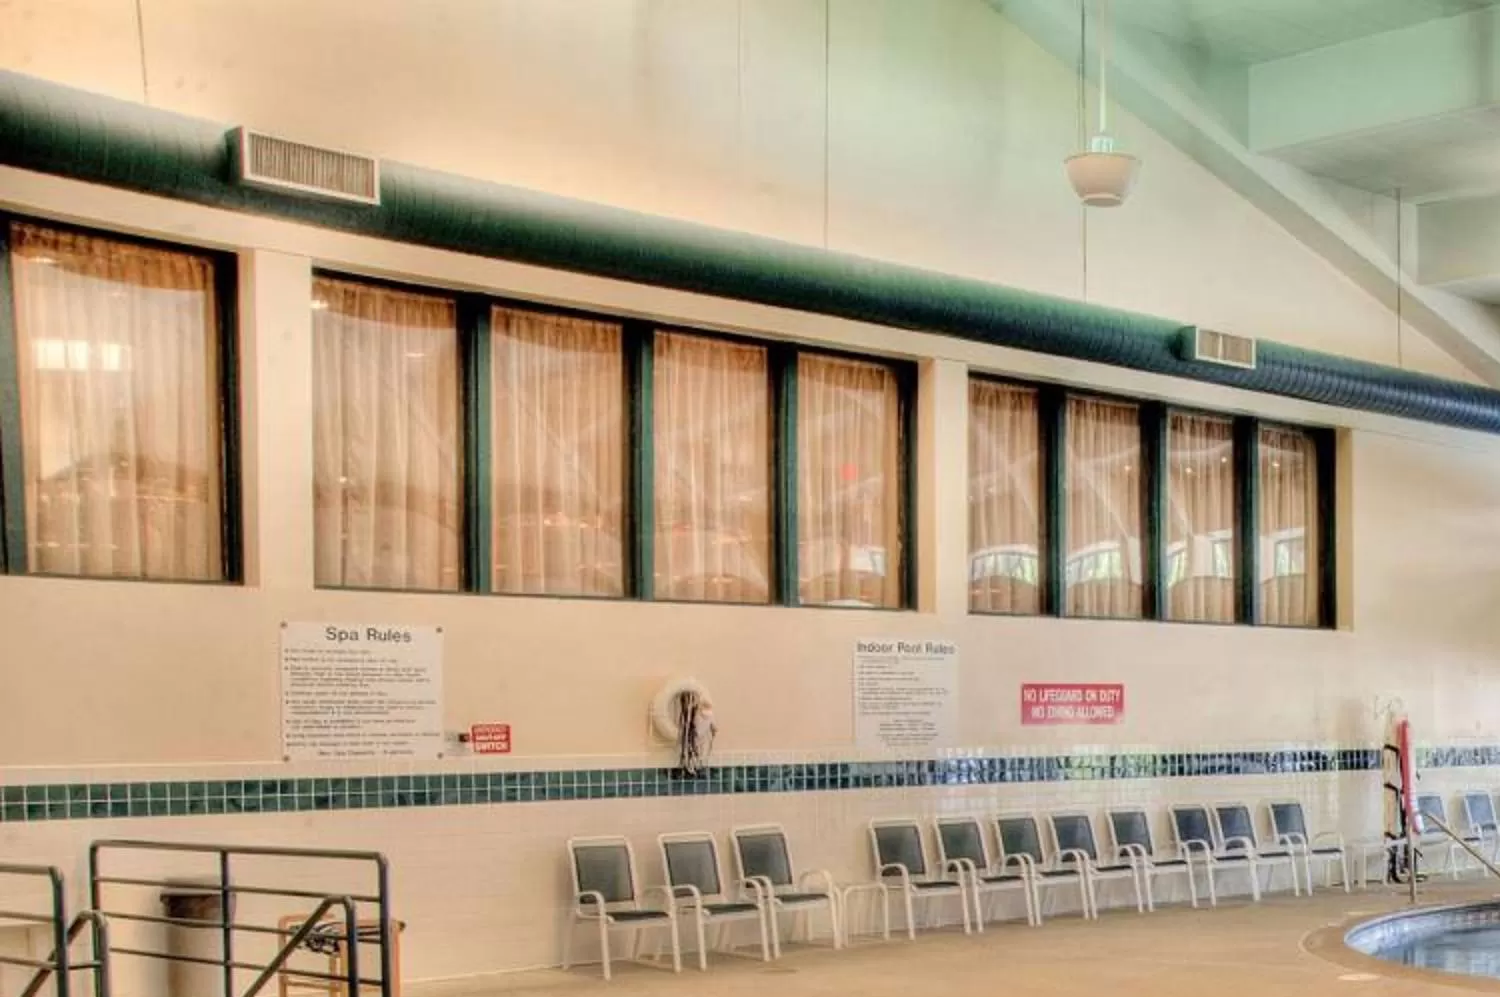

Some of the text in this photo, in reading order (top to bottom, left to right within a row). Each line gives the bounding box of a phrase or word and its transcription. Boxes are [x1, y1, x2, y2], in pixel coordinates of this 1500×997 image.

[325, 627, 412, 643] Spa Rules
[857, 642, 893, 653] Indoor
[925, 642, 955, 654] Rules
[1023, 688, 1120, 703] NO LIFEGUARD ON DUTY
[1032, 705, 1045, 719] NO
